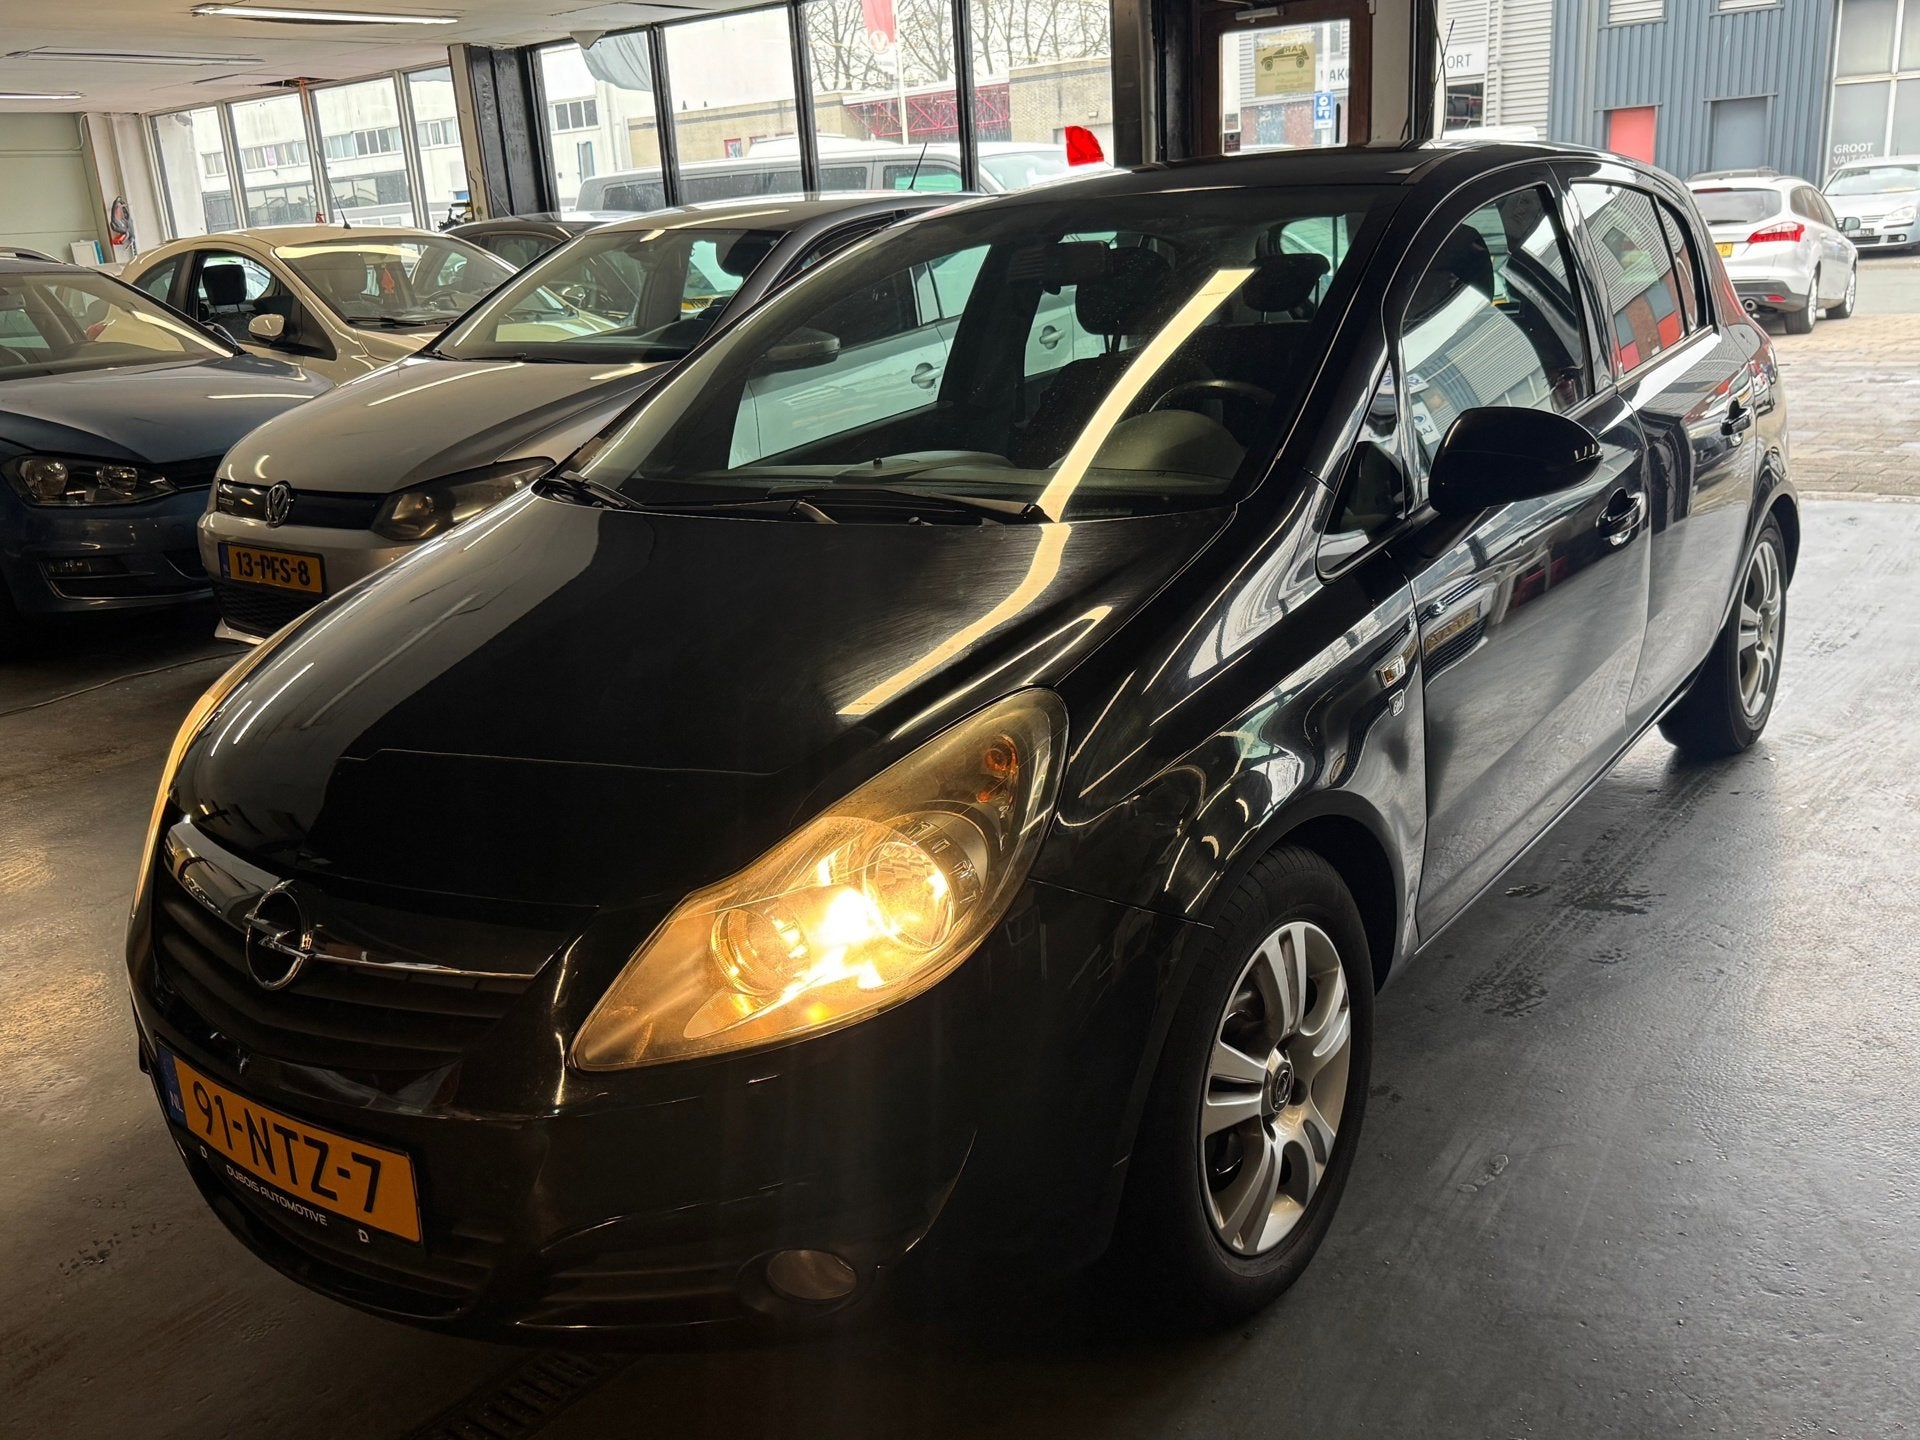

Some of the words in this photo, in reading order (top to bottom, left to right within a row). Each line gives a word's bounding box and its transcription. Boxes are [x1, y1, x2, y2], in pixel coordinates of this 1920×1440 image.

[1834, 143, 1874, 154] GROOT
[235, 551, 311, 586] 13-PFS-8
[192, 1080, 382, 1214] 91-NTZ-7
[225, 1164, 260, 1193] DUBOIS
[260, 1186, 328, 1226] AUTOMOTIVE
